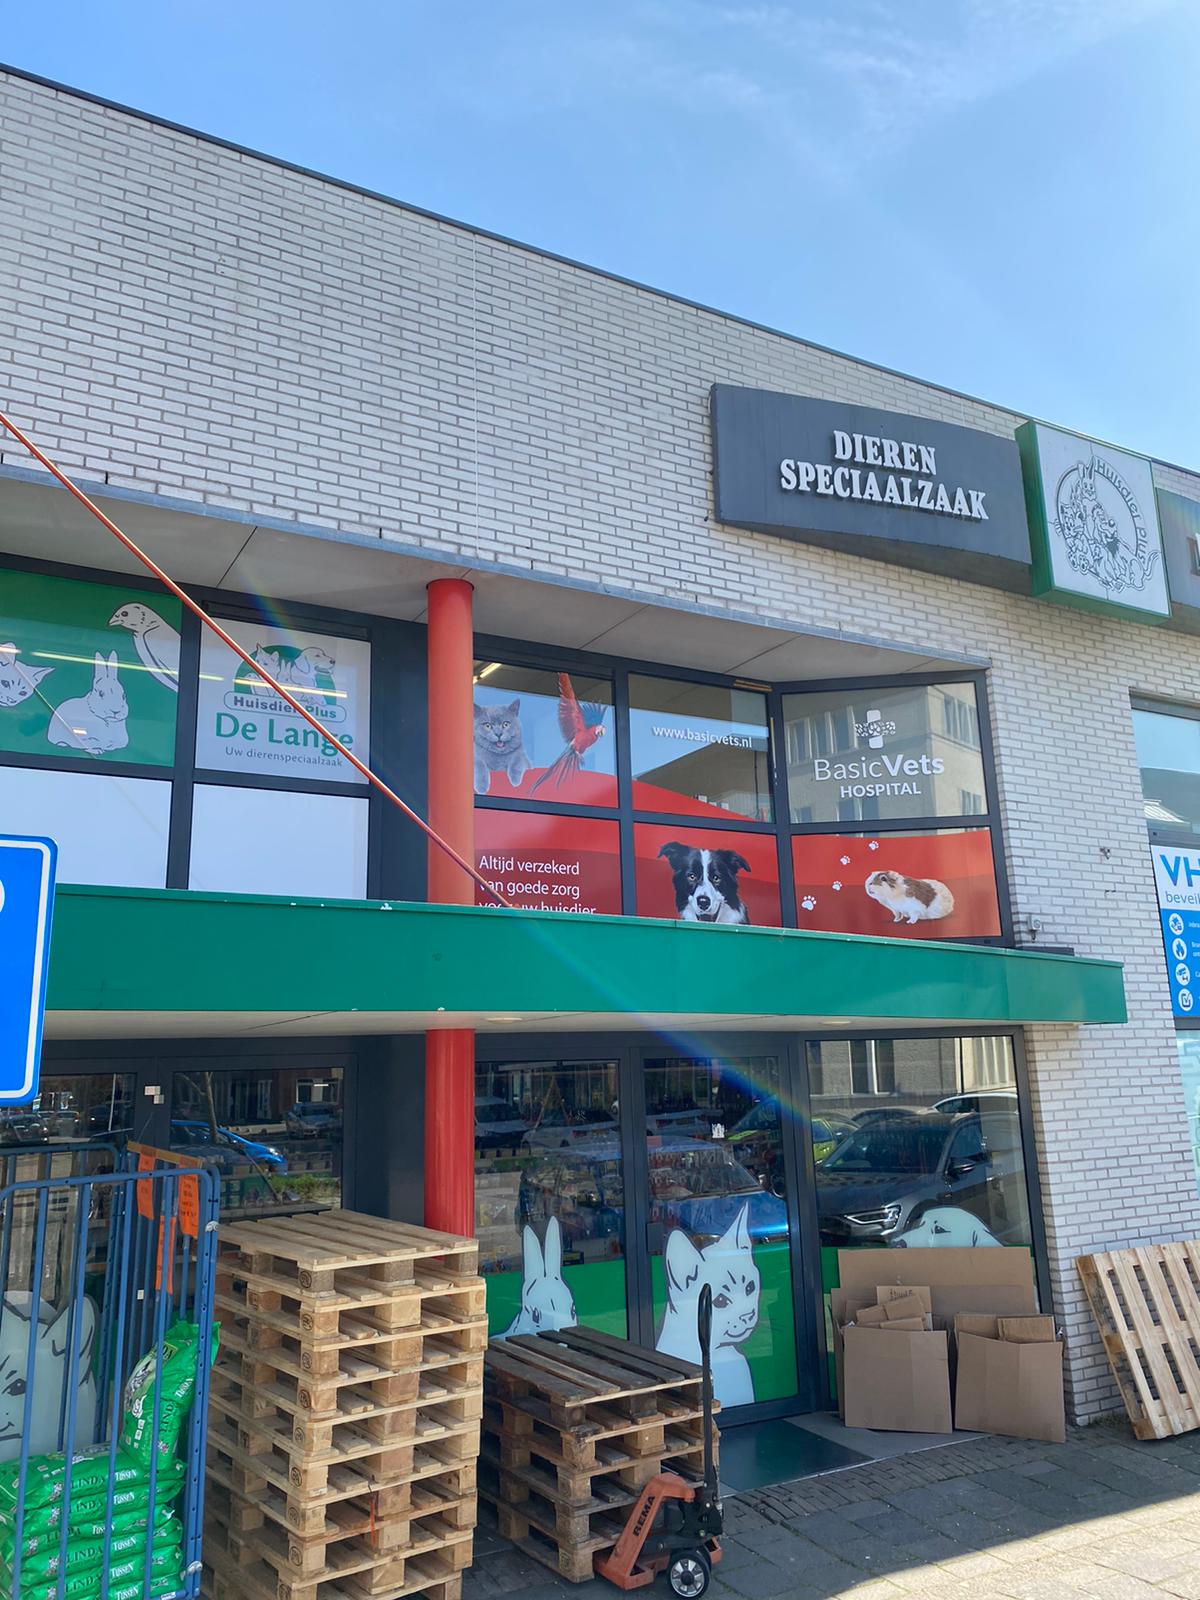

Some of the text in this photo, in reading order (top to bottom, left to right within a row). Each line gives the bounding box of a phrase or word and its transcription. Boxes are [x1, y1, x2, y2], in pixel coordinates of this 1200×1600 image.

[833, 429, 937, 475] DIEREN
[780, 458, 989, 521] SPECIAALZAAK
[215, 712, 354, 758] De Lange
[652, 725, 753, 748] www.basicvets.nl
[225, 746, 343, 767] Uw dierenspeciaalzaak
[813, 753, 945, 781] BasicVets
[840, 782, 922, 799] HOSPITAL
[479, 855, 580, 875] Altijd verzekerd
[507, 880, 549, 896] goede
[551, 884, 580, 900] zorg
[632, 1496, 656, 1537] REMA
